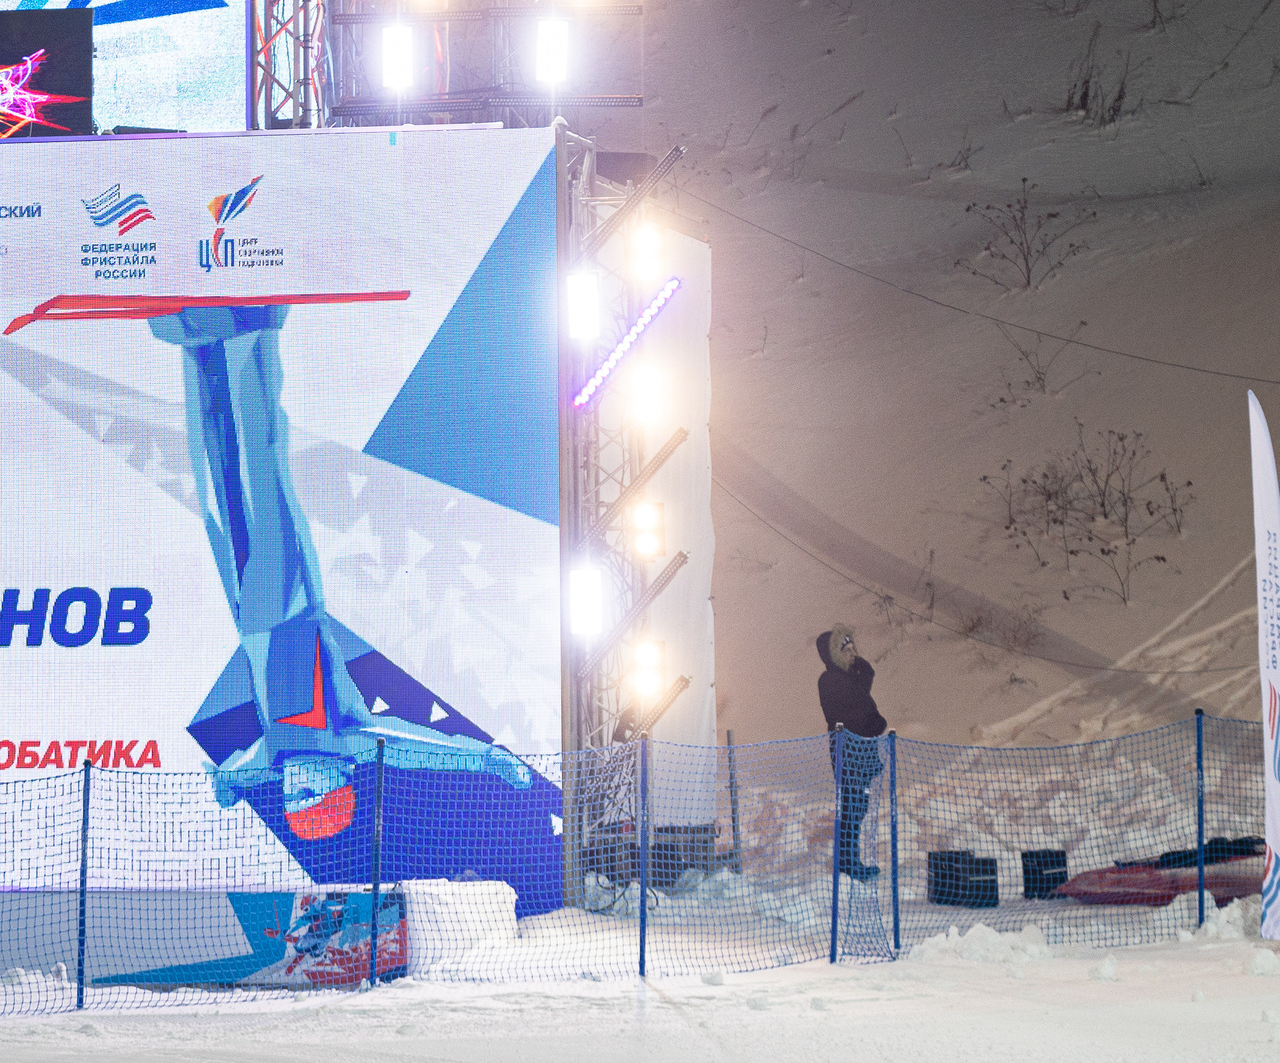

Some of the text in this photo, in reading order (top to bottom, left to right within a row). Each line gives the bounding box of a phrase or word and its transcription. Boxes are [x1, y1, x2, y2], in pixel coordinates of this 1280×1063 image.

[81, 242, 157, 255] ФЕДЕРАЦИЯ
[81, 254, 157, 267] ФРИСТАЙЛА
[95, 268, 147, 280] РОССИИ
